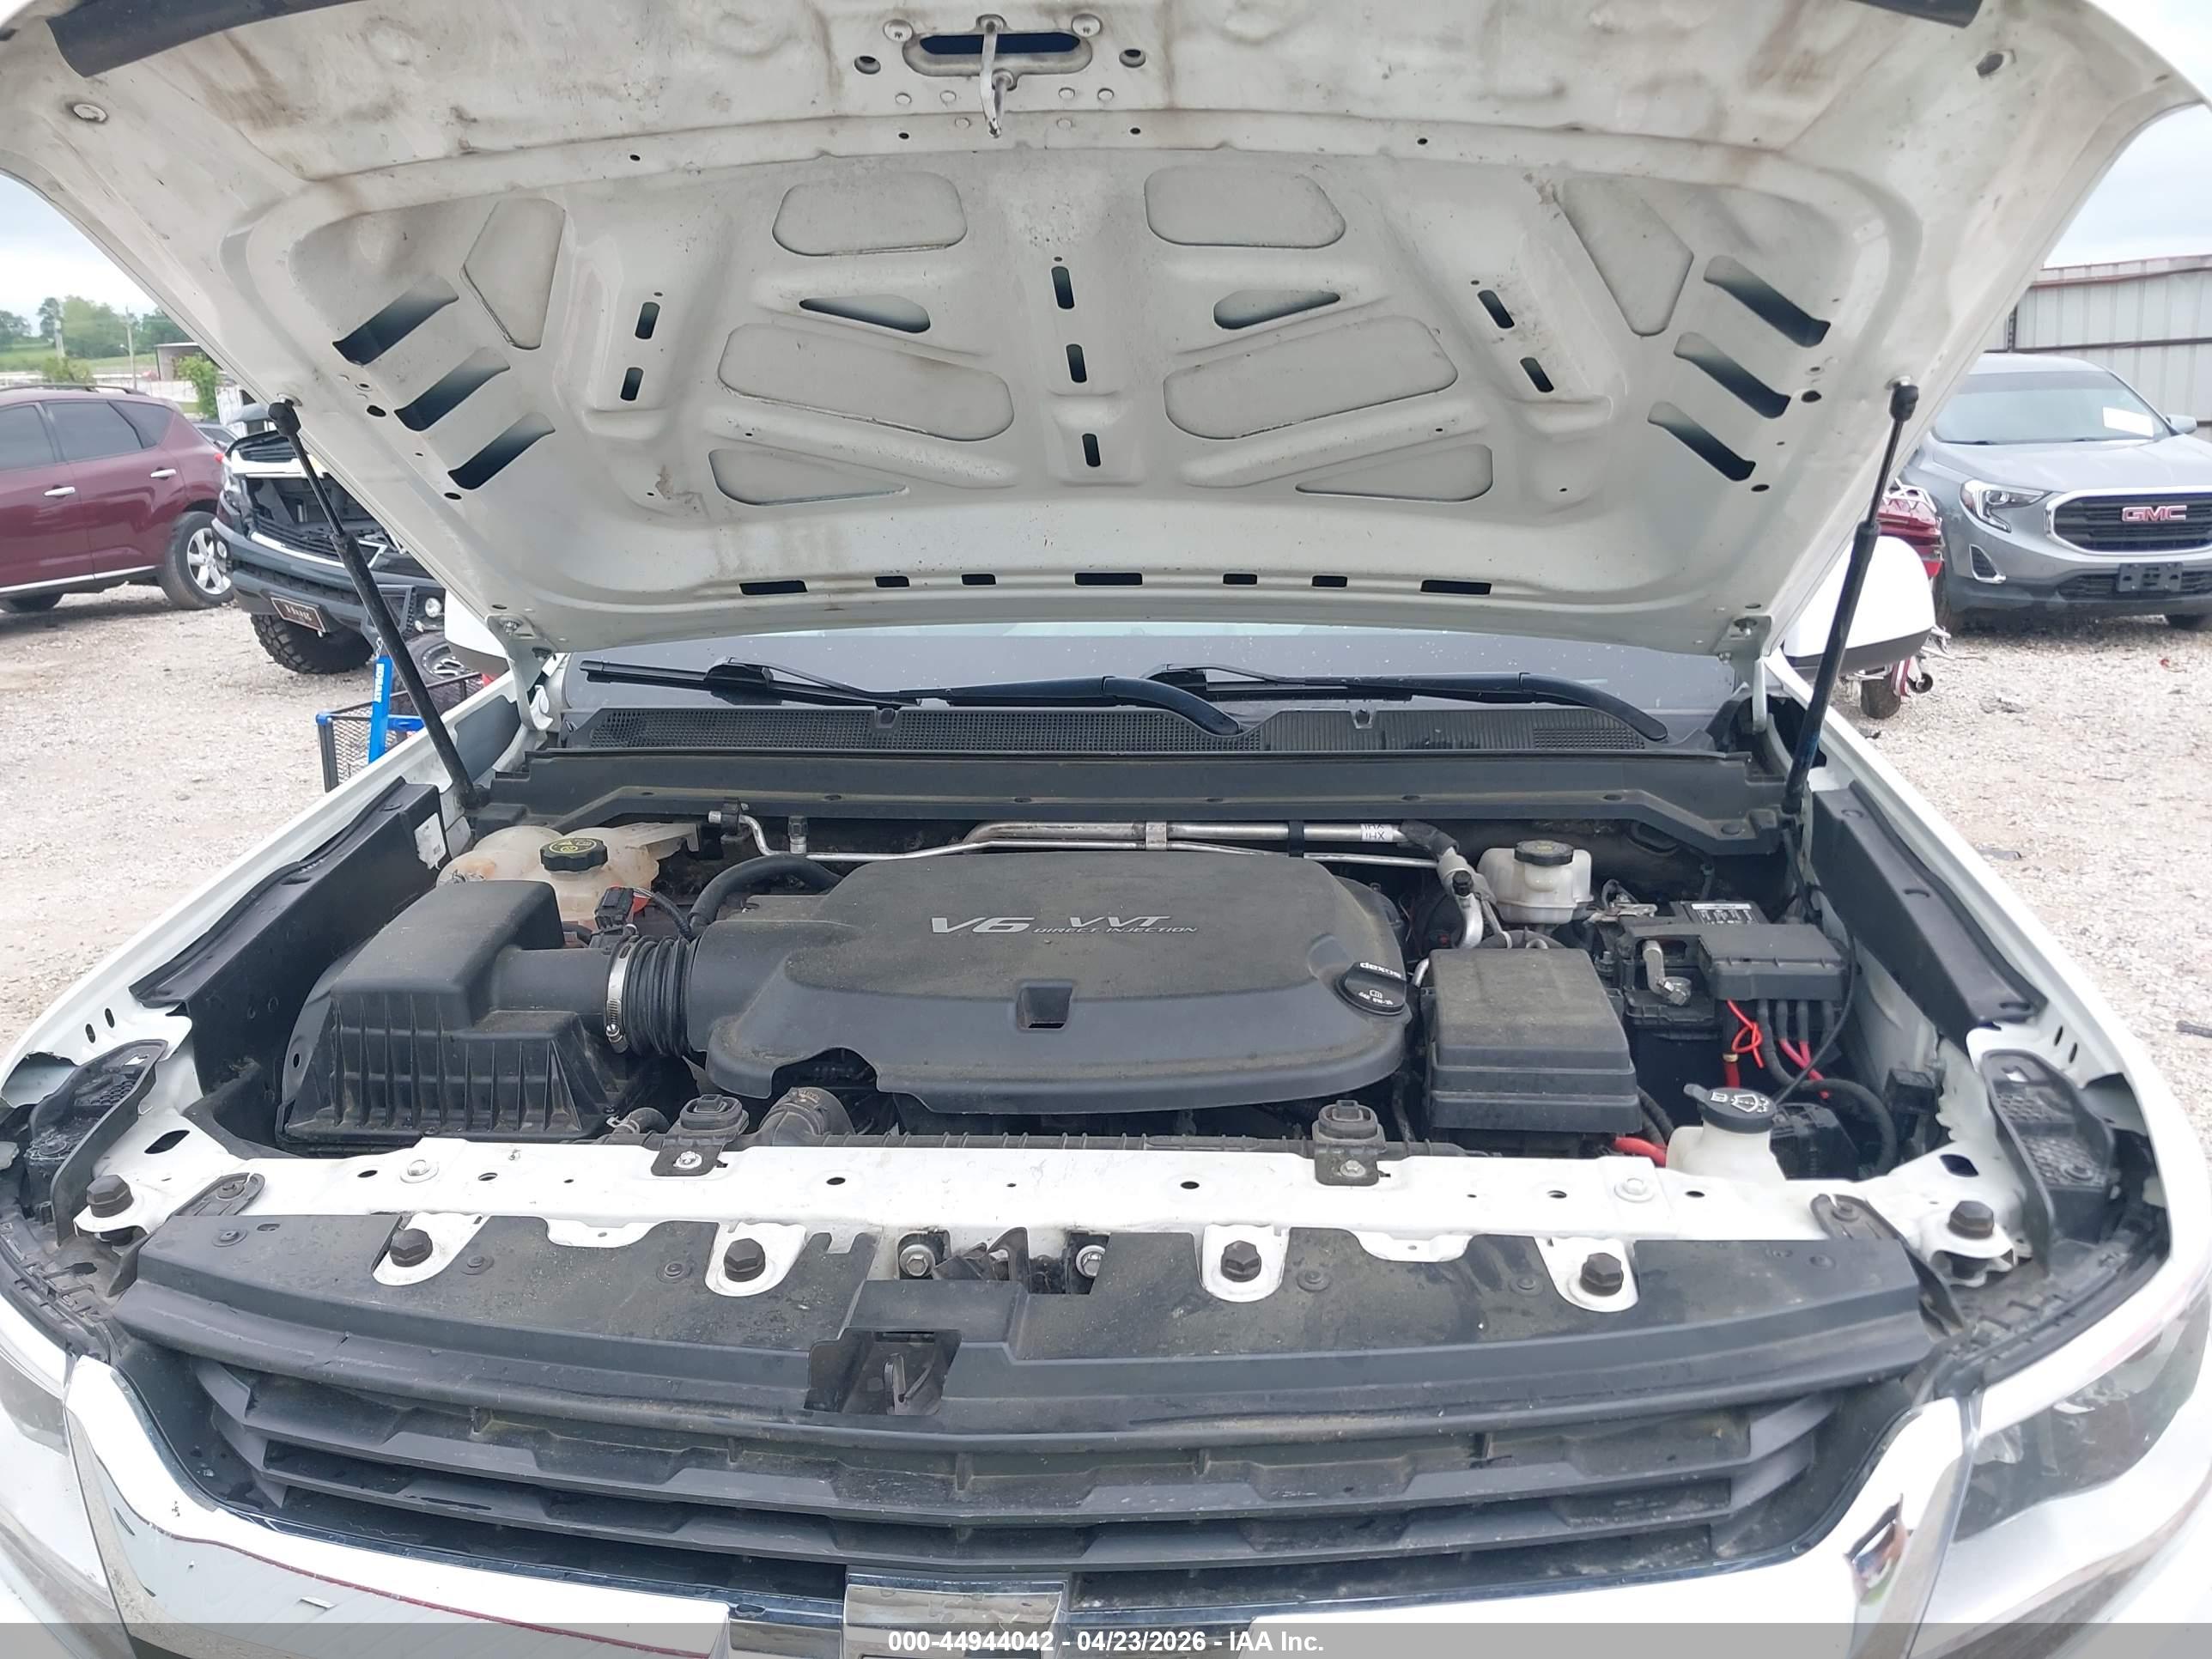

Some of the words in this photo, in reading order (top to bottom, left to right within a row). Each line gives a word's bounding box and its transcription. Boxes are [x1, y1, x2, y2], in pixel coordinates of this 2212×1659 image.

[2122, 505, 2187, 521] GMC
[932, 917, 1035, 933] V6
[1070, 915, 1170, 927] VVT
[1359, 962, 1401, 979] dexos
